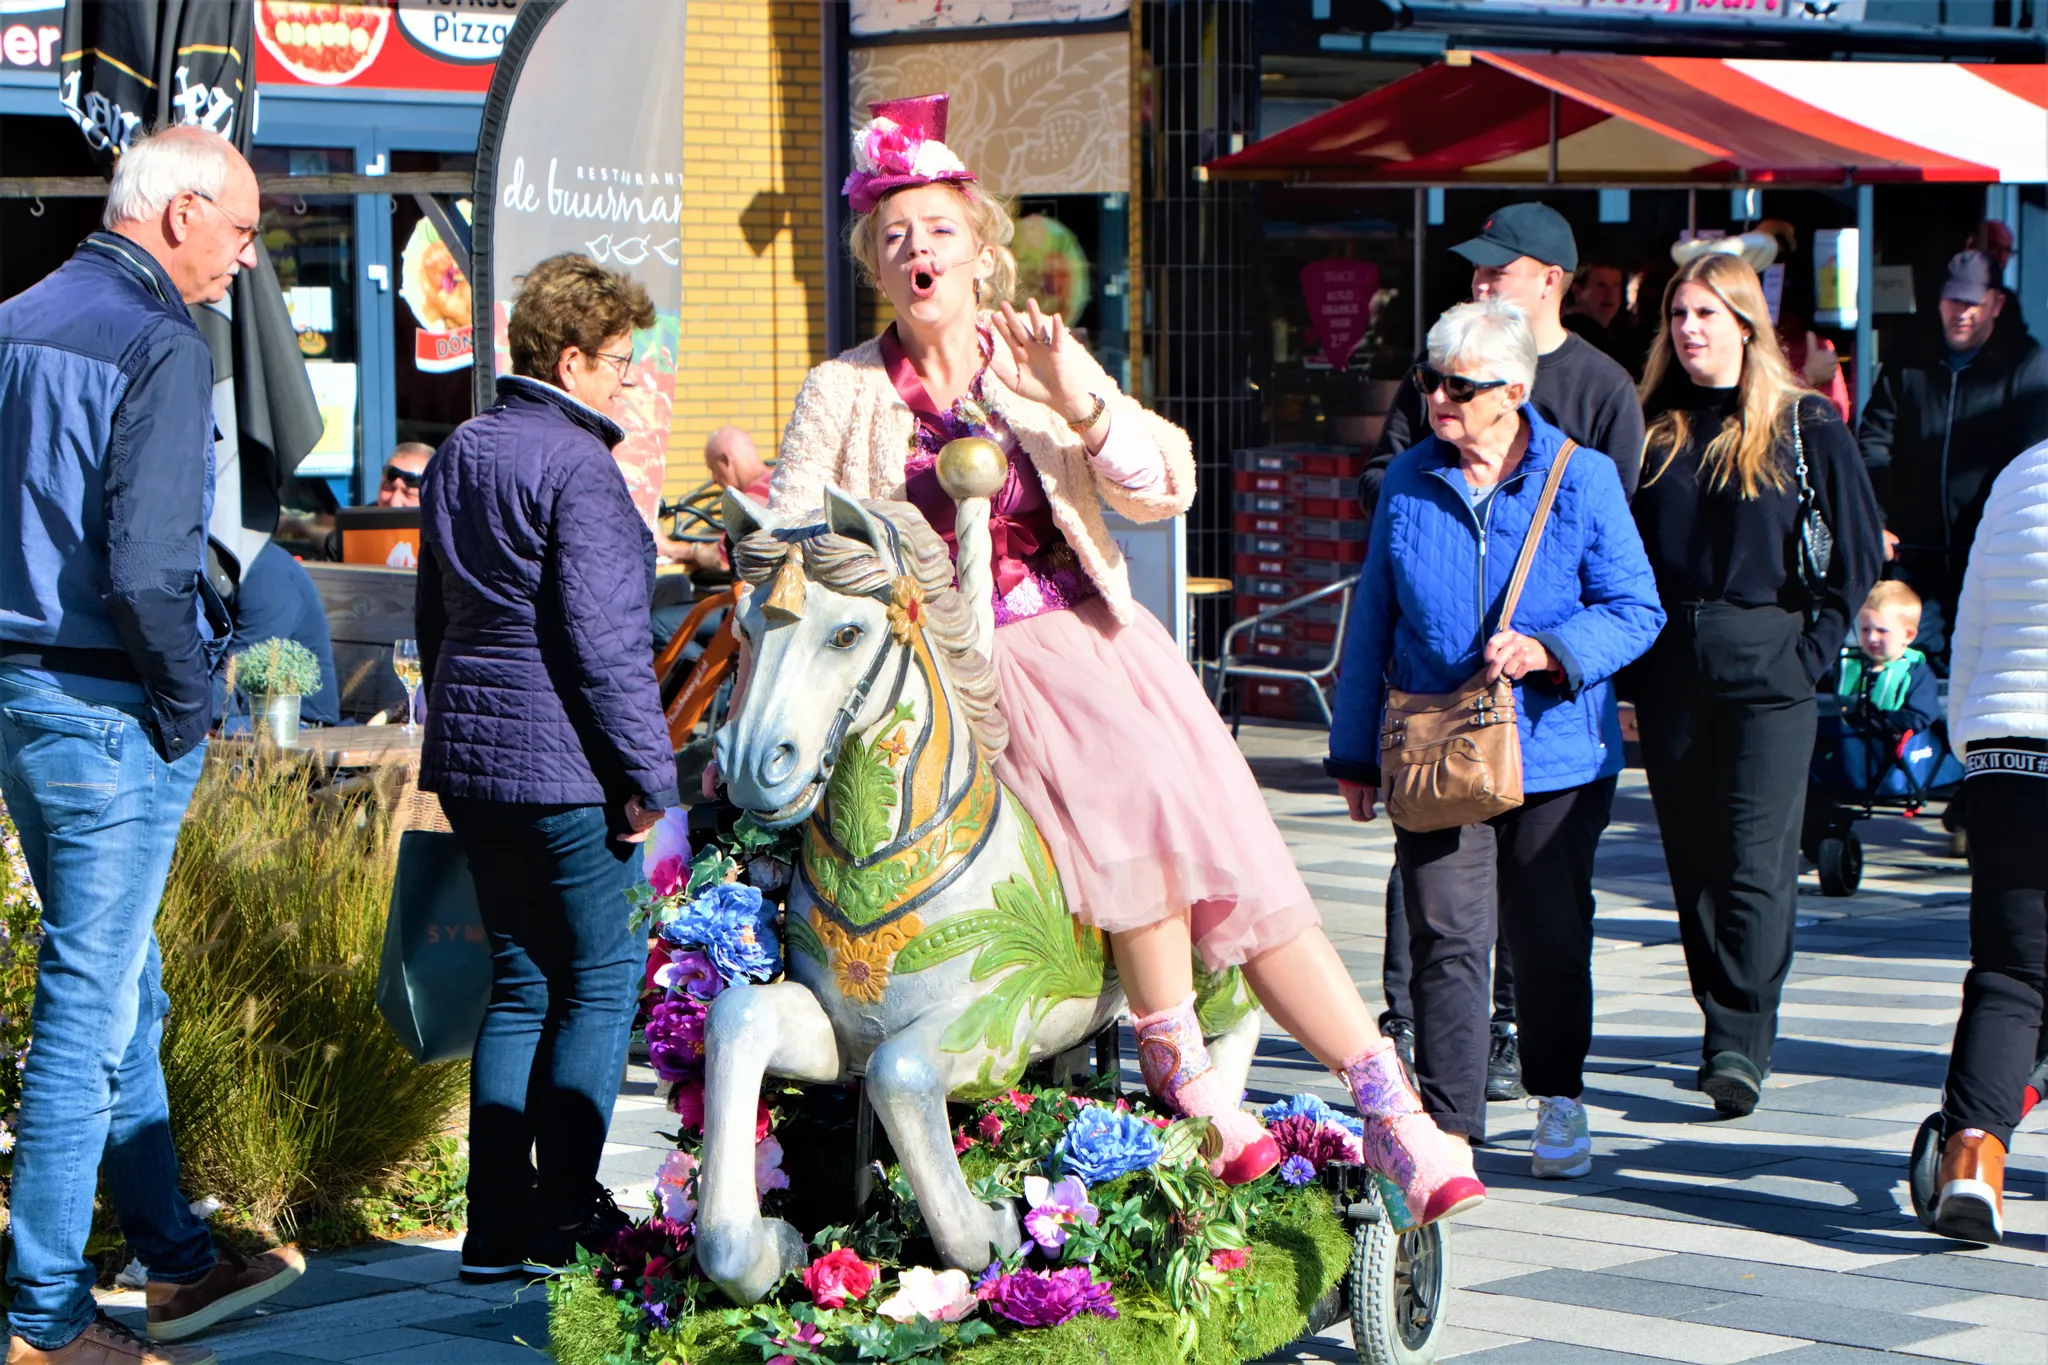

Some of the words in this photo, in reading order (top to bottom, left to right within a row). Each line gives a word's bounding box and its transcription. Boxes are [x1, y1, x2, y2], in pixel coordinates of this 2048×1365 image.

[0, 23, 61, 66] er
[434, 11, 507, 44] Pizza
[503, 156, 540, 212] de
[2003, 754, 2037, 771] OUT
